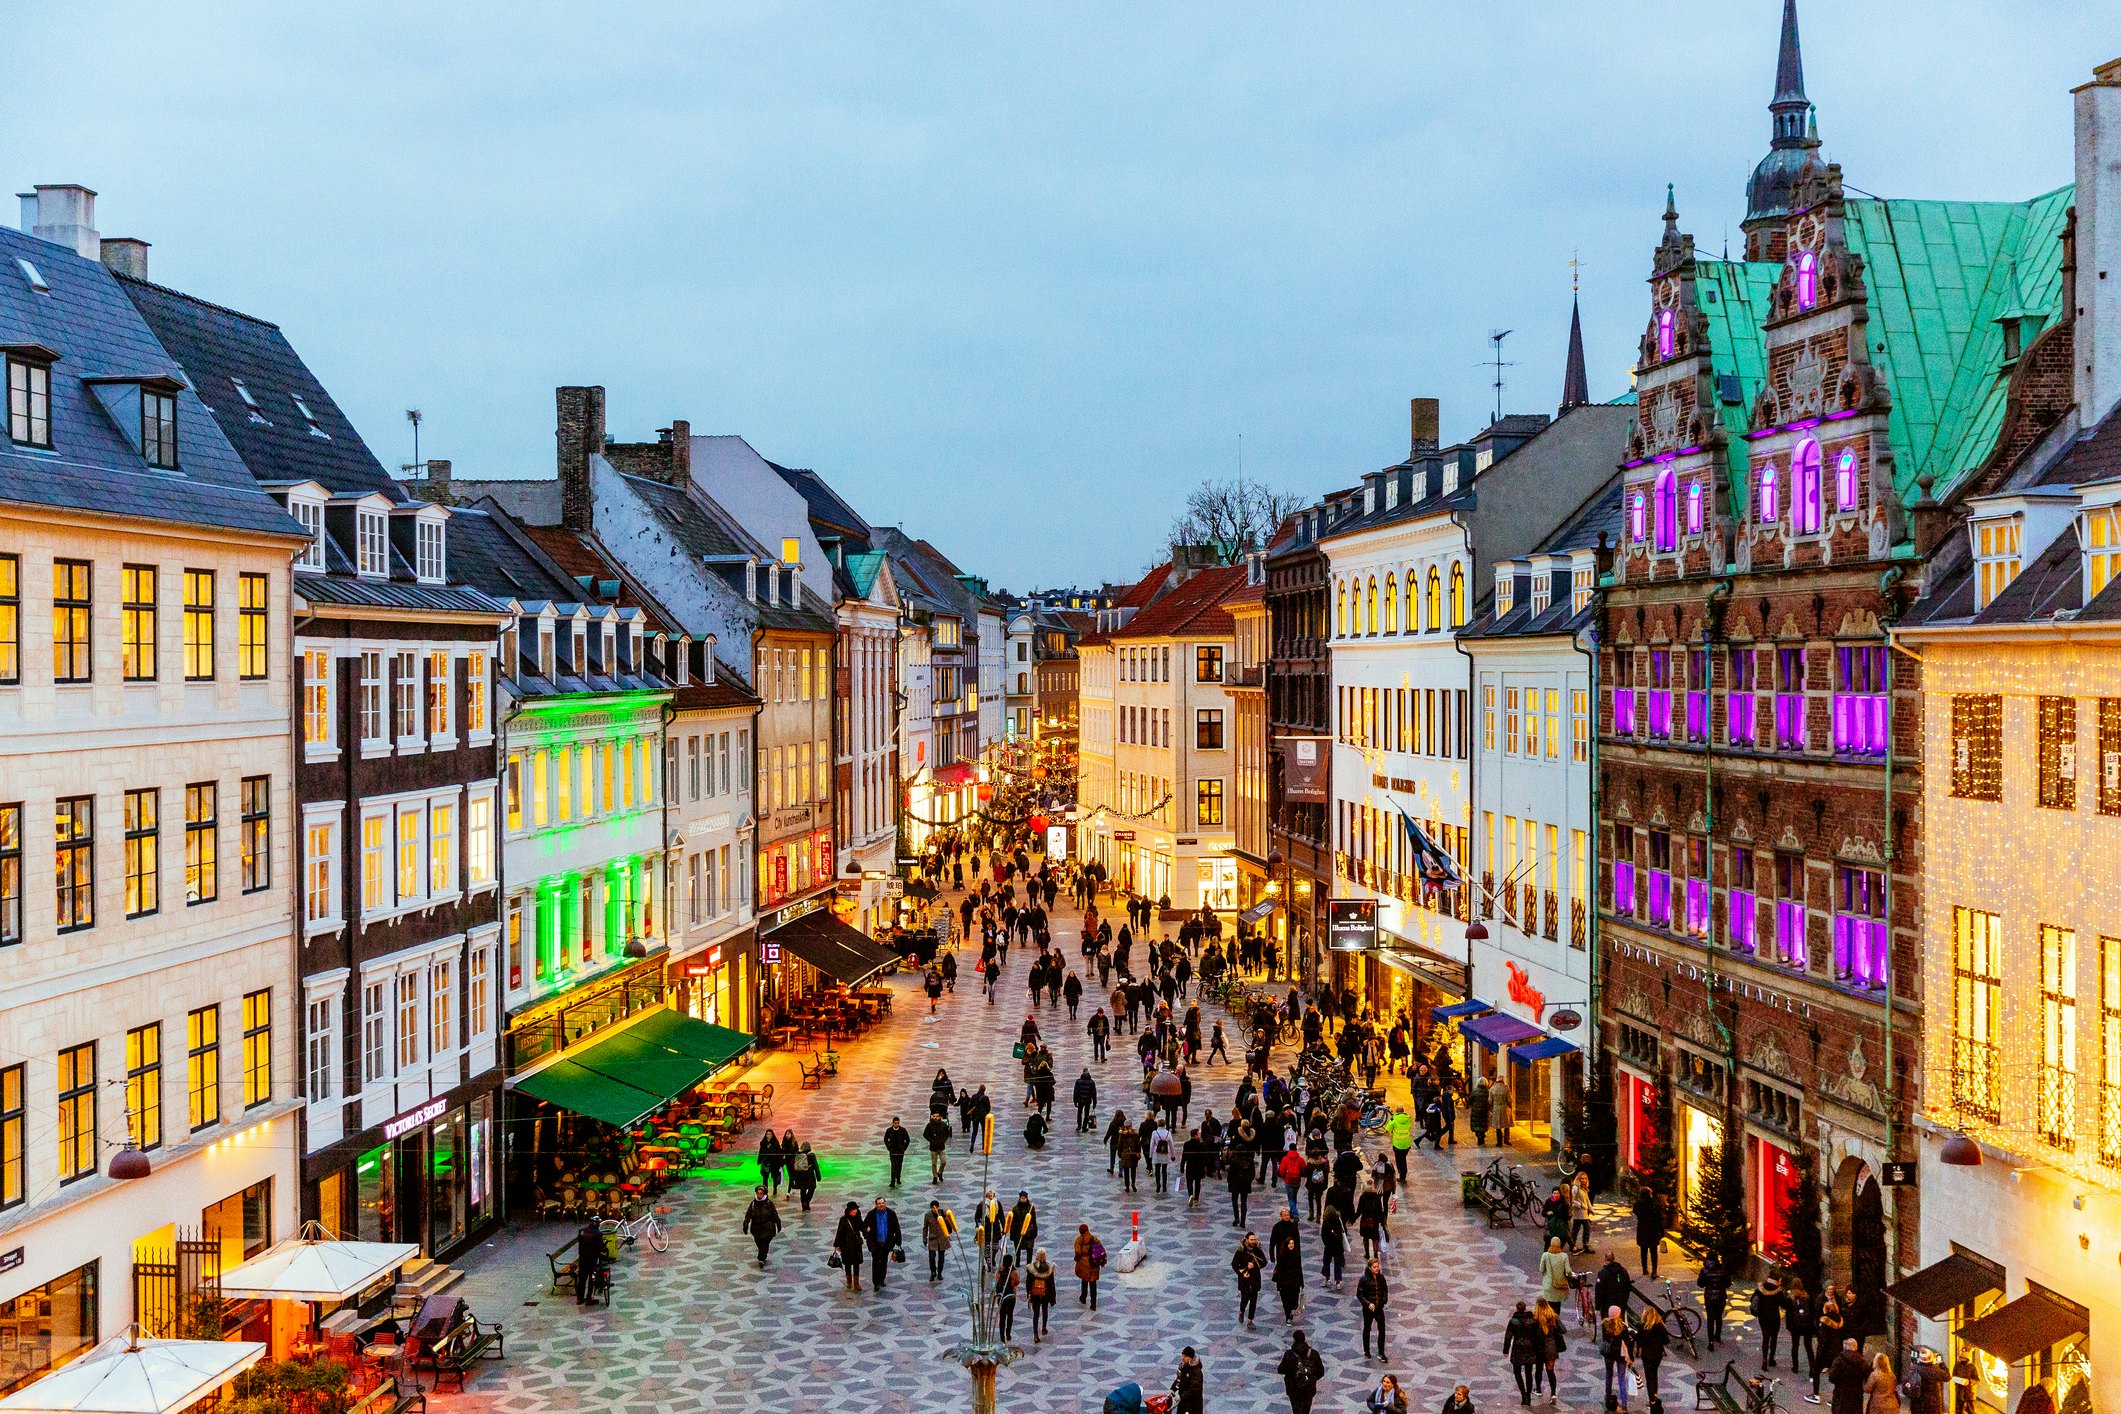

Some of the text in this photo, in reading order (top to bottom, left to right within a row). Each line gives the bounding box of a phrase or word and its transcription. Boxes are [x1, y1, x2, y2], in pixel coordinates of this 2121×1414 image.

[1304, 788, 1325, 796] Bolighus
[823, 853, 831, 874] Floor
[1350, 924, 1374, 932] Bolighus
[1611, 939, 1810, 1018] ROYAL COPENHAGEN
[385, 1098, 447, 1140] VICTORIA'S SECRET
